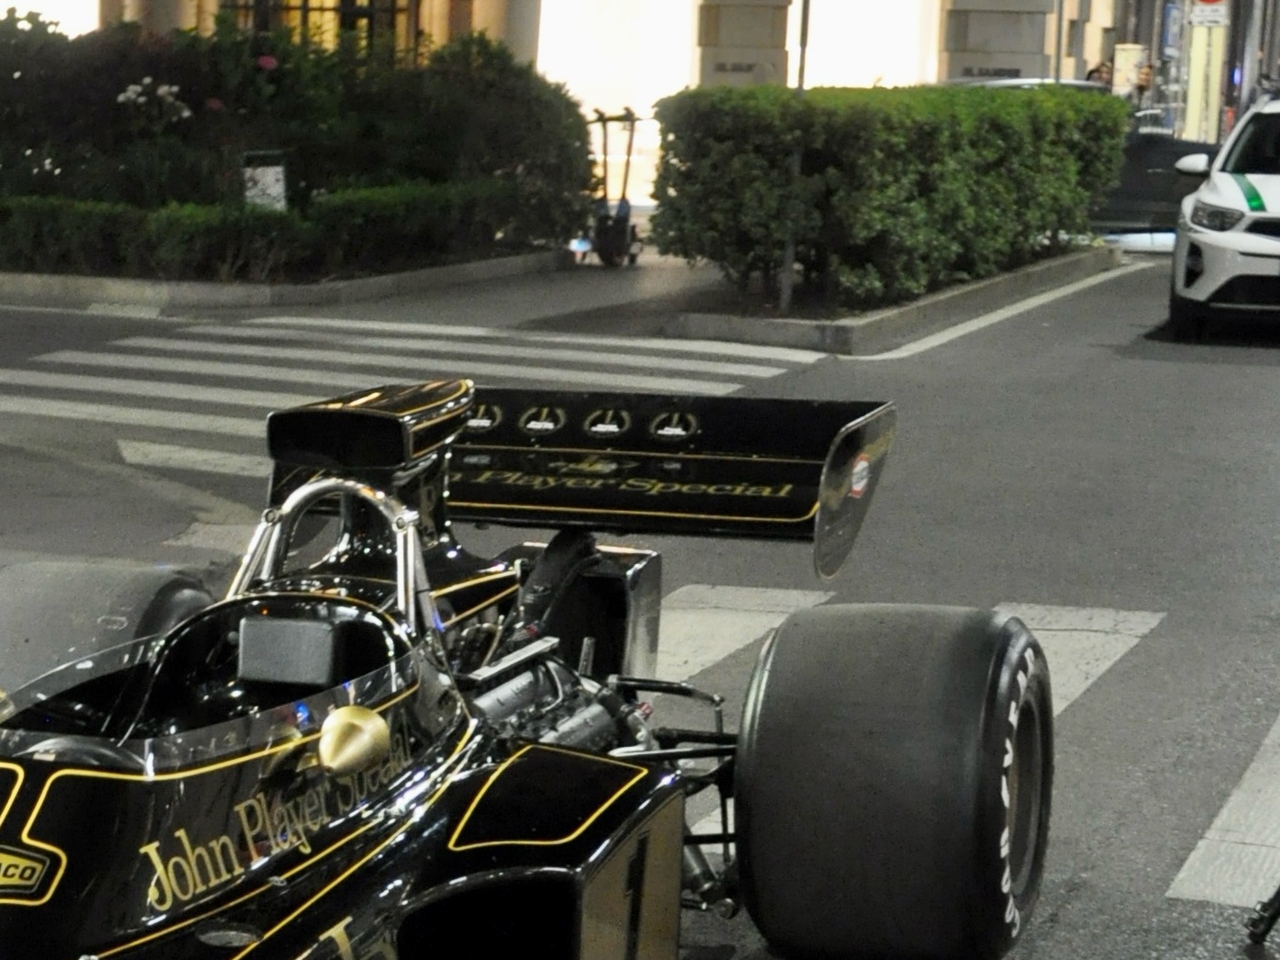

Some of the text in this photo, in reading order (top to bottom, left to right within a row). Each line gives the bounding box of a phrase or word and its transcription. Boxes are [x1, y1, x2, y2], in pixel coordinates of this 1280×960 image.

[474, 470, 617, 490] Player
[620, 477, 793, 497] Special
[139, 828, 244, 912] John
[233, 772, 332, 862] Player
